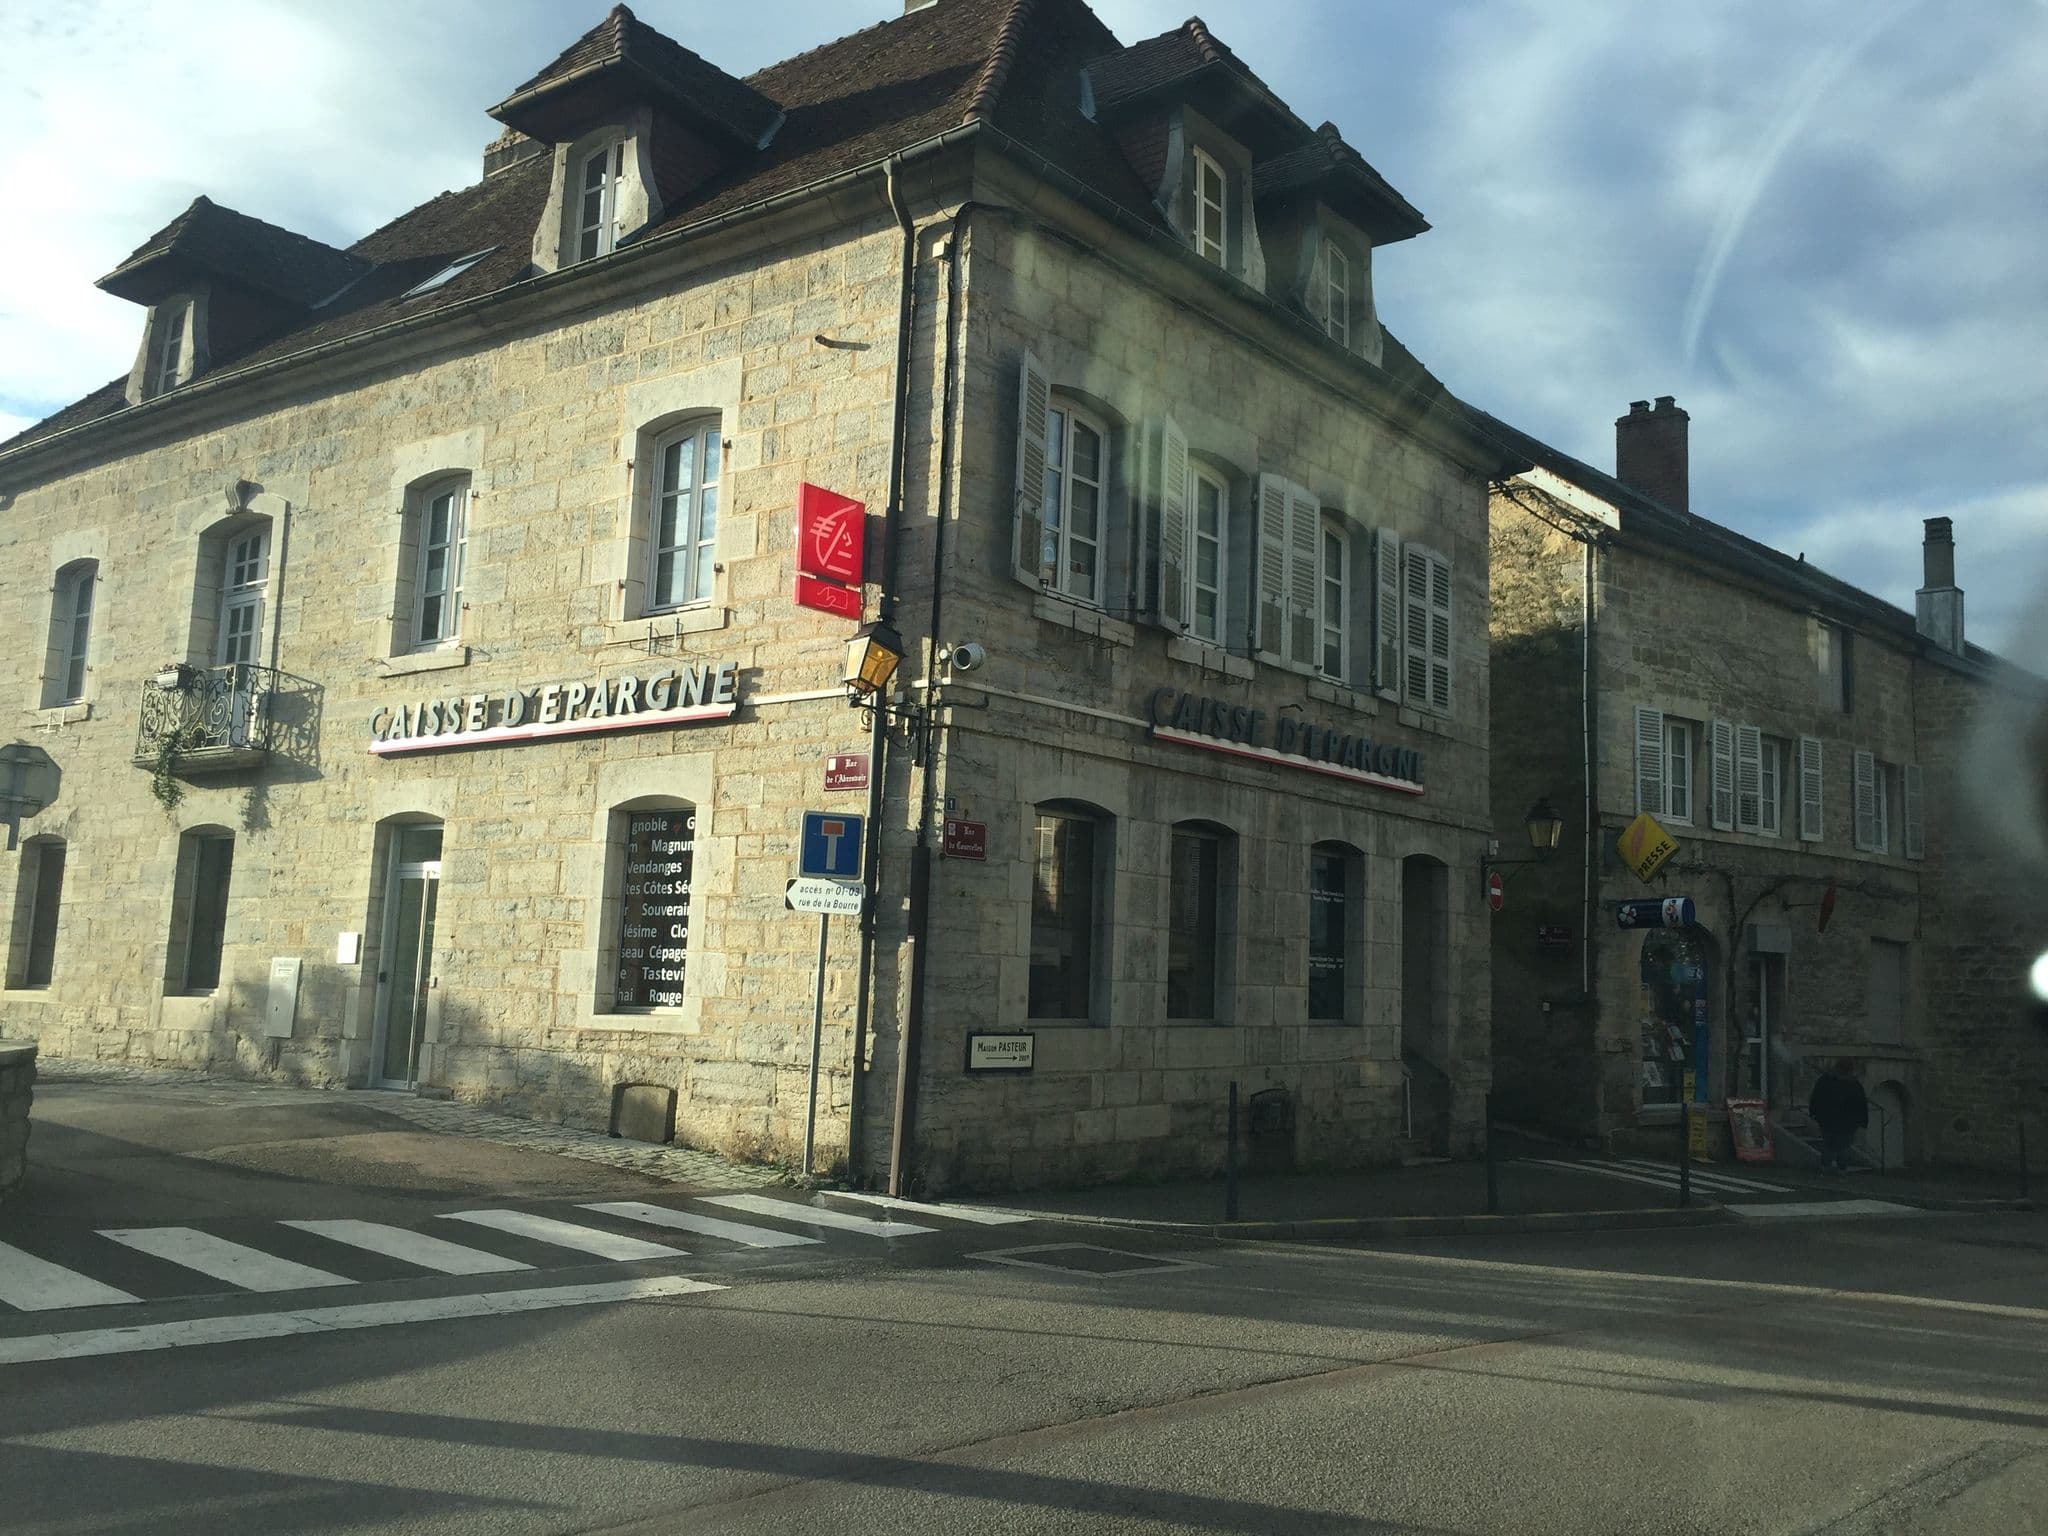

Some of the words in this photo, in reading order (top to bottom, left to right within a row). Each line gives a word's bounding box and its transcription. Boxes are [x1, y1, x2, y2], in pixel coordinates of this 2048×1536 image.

[368, 694, 488, 743] CAISSE
[502, 661, 739, 727] D'EPARGNE
[1152, 687, 1265, 745] CAISSE
[1278, 717, 1425, 784] D'EPARGNE
[845, 758, 858, 770] Rue
[827, 776, 834, 784] de
[1638, 840, 1672, 876] PRESSE
[628, 860, 682, 876] Vendanges
[643, 880, 673, 895] Côtes
[800, 884, 822, 894] accès
[835, 886, 860, 897] 01-03
[798, 899, 810, 907] rue
[813, 898, 822, 908] de
[824, 899, 831, 908] la
[649, 988, 683, 1006] Rouge
[998, 1041, 1027, 1052] PASTEUR
